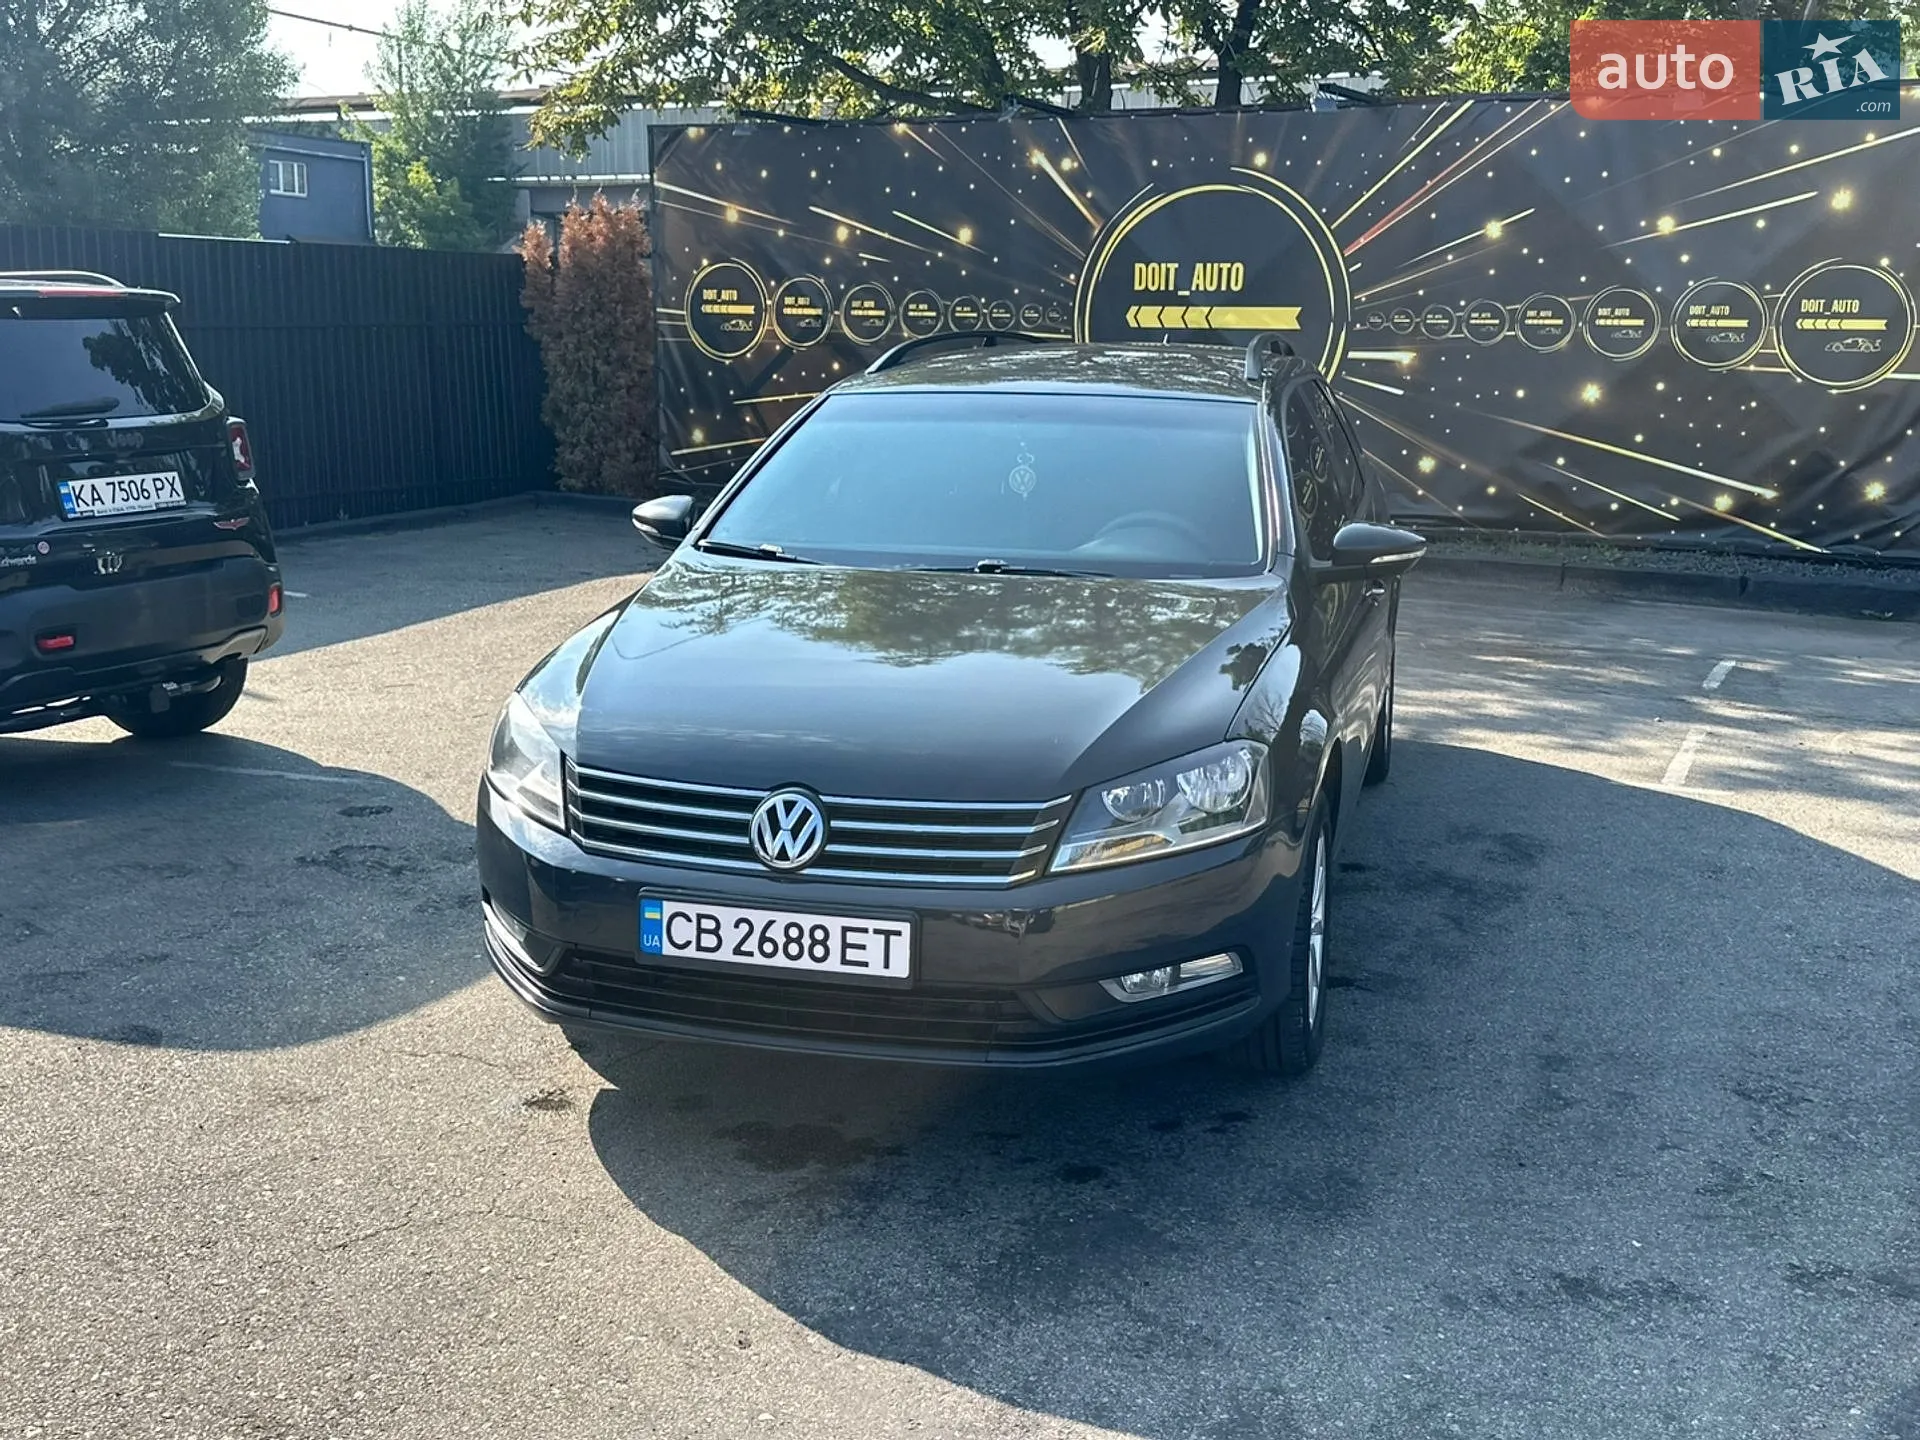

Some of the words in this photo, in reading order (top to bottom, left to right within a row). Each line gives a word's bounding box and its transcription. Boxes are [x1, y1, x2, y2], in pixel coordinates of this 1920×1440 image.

[1133, 262, 1246, 297] DOIT_AUTO
[1801, 299, 1860, 316] DOIT_AUTO
[71, 483, 106, 508] KA
[105, 478, 151, 505] 7506
[152, 475, 181, 500] PX
[643, 933, 661, 949] UA
[664, 911, 724, 954] CB
[731, 916, 831, 964] 2688
[839, 925, 903, 970] ET
